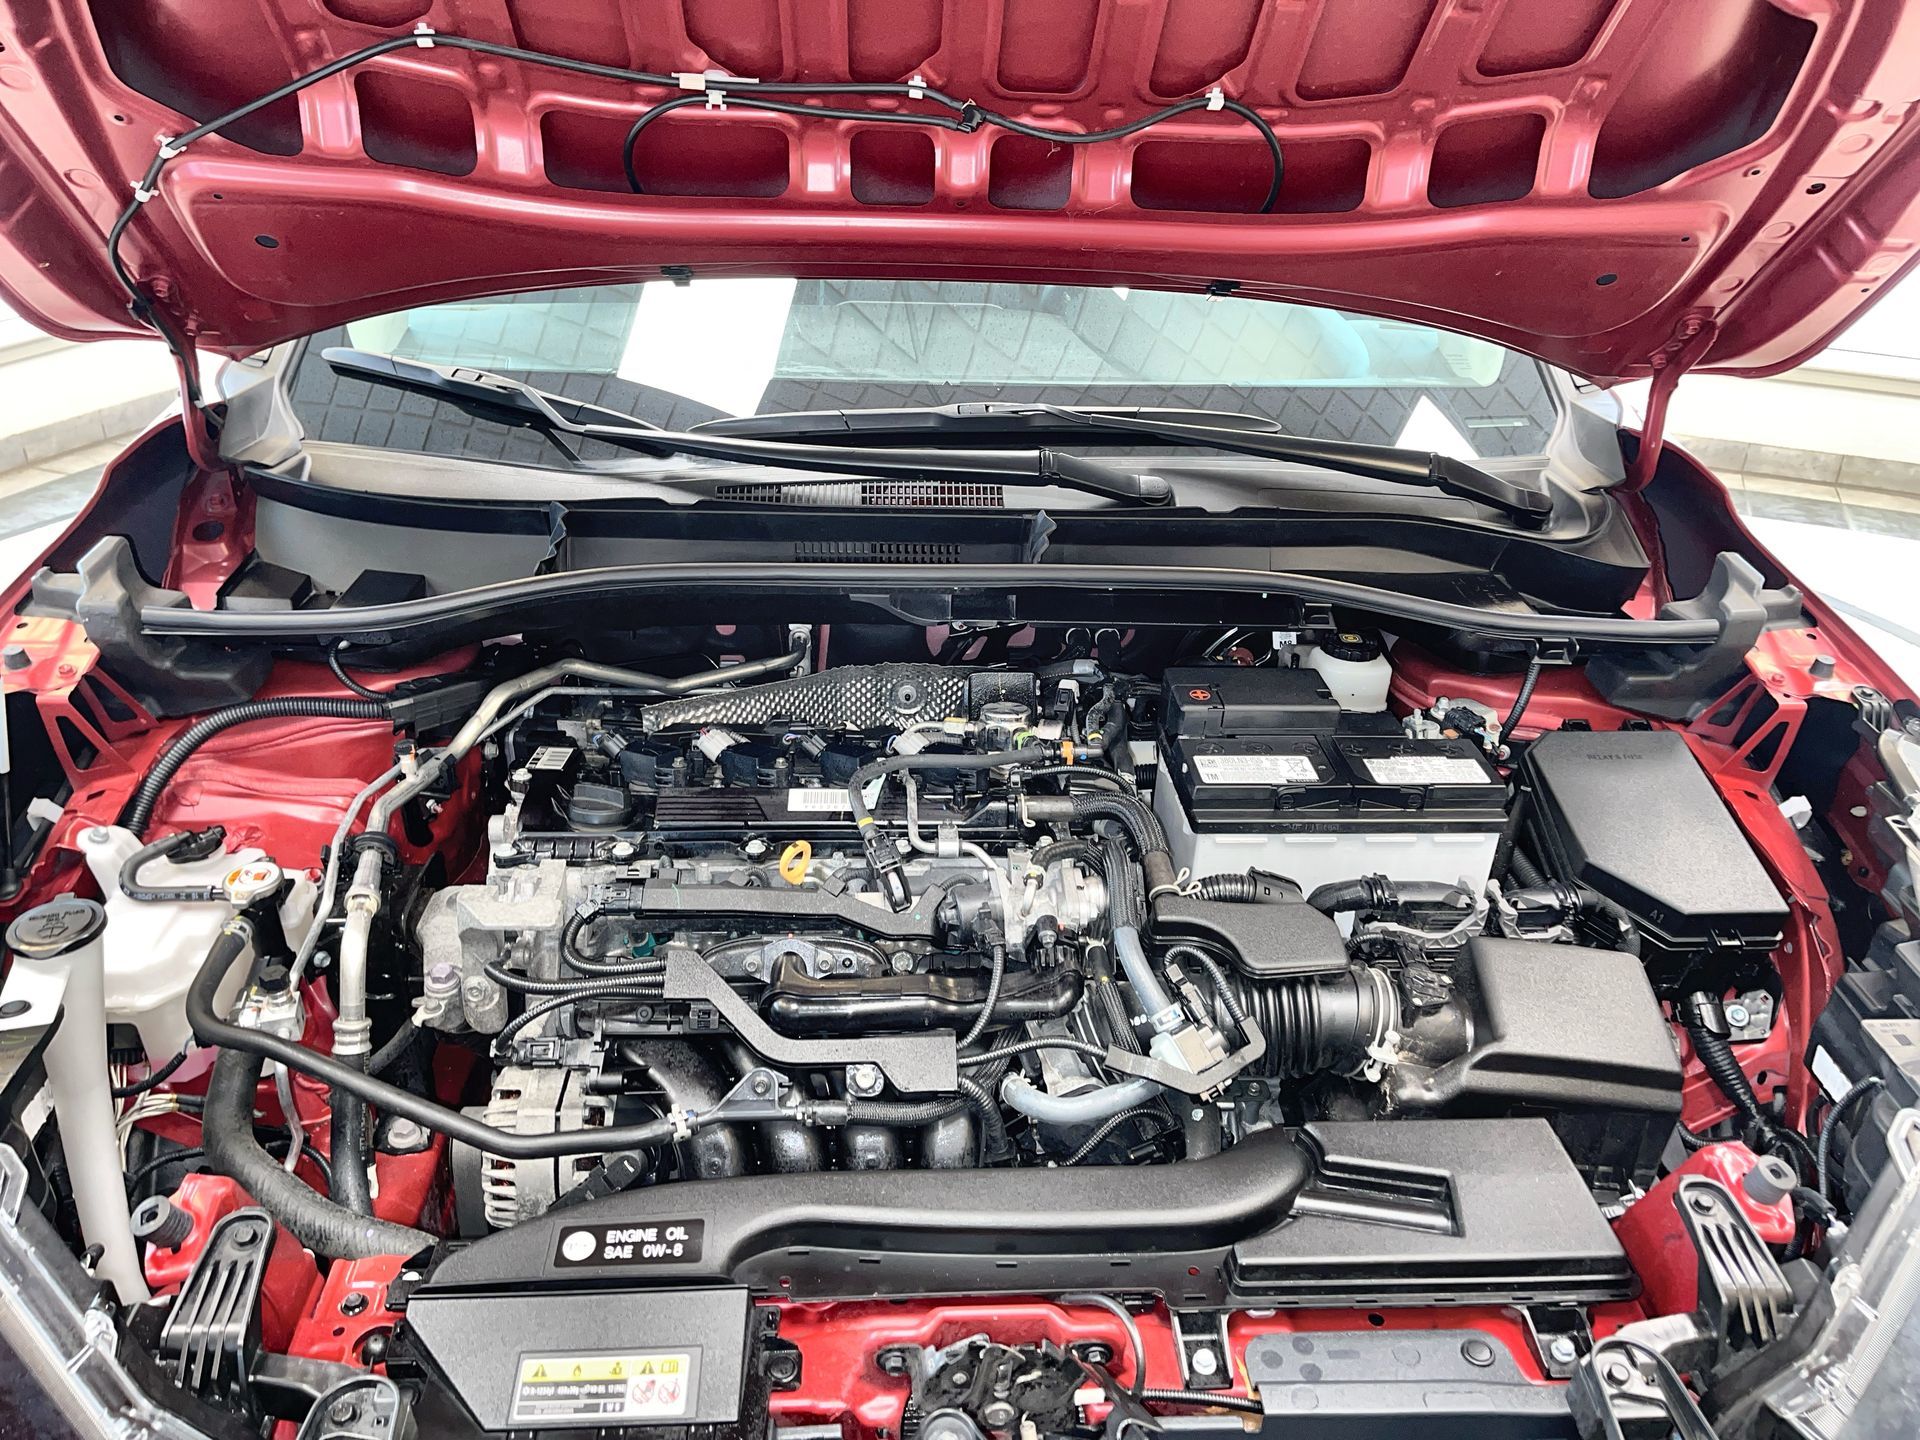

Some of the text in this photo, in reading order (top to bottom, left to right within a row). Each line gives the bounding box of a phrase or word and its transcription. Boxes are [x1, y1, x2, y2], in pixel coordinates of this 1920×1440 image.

[606, 1226, 689, 1243] ENGINE OIL
[603, 1243, 683, 1259] SAE 0W-8
